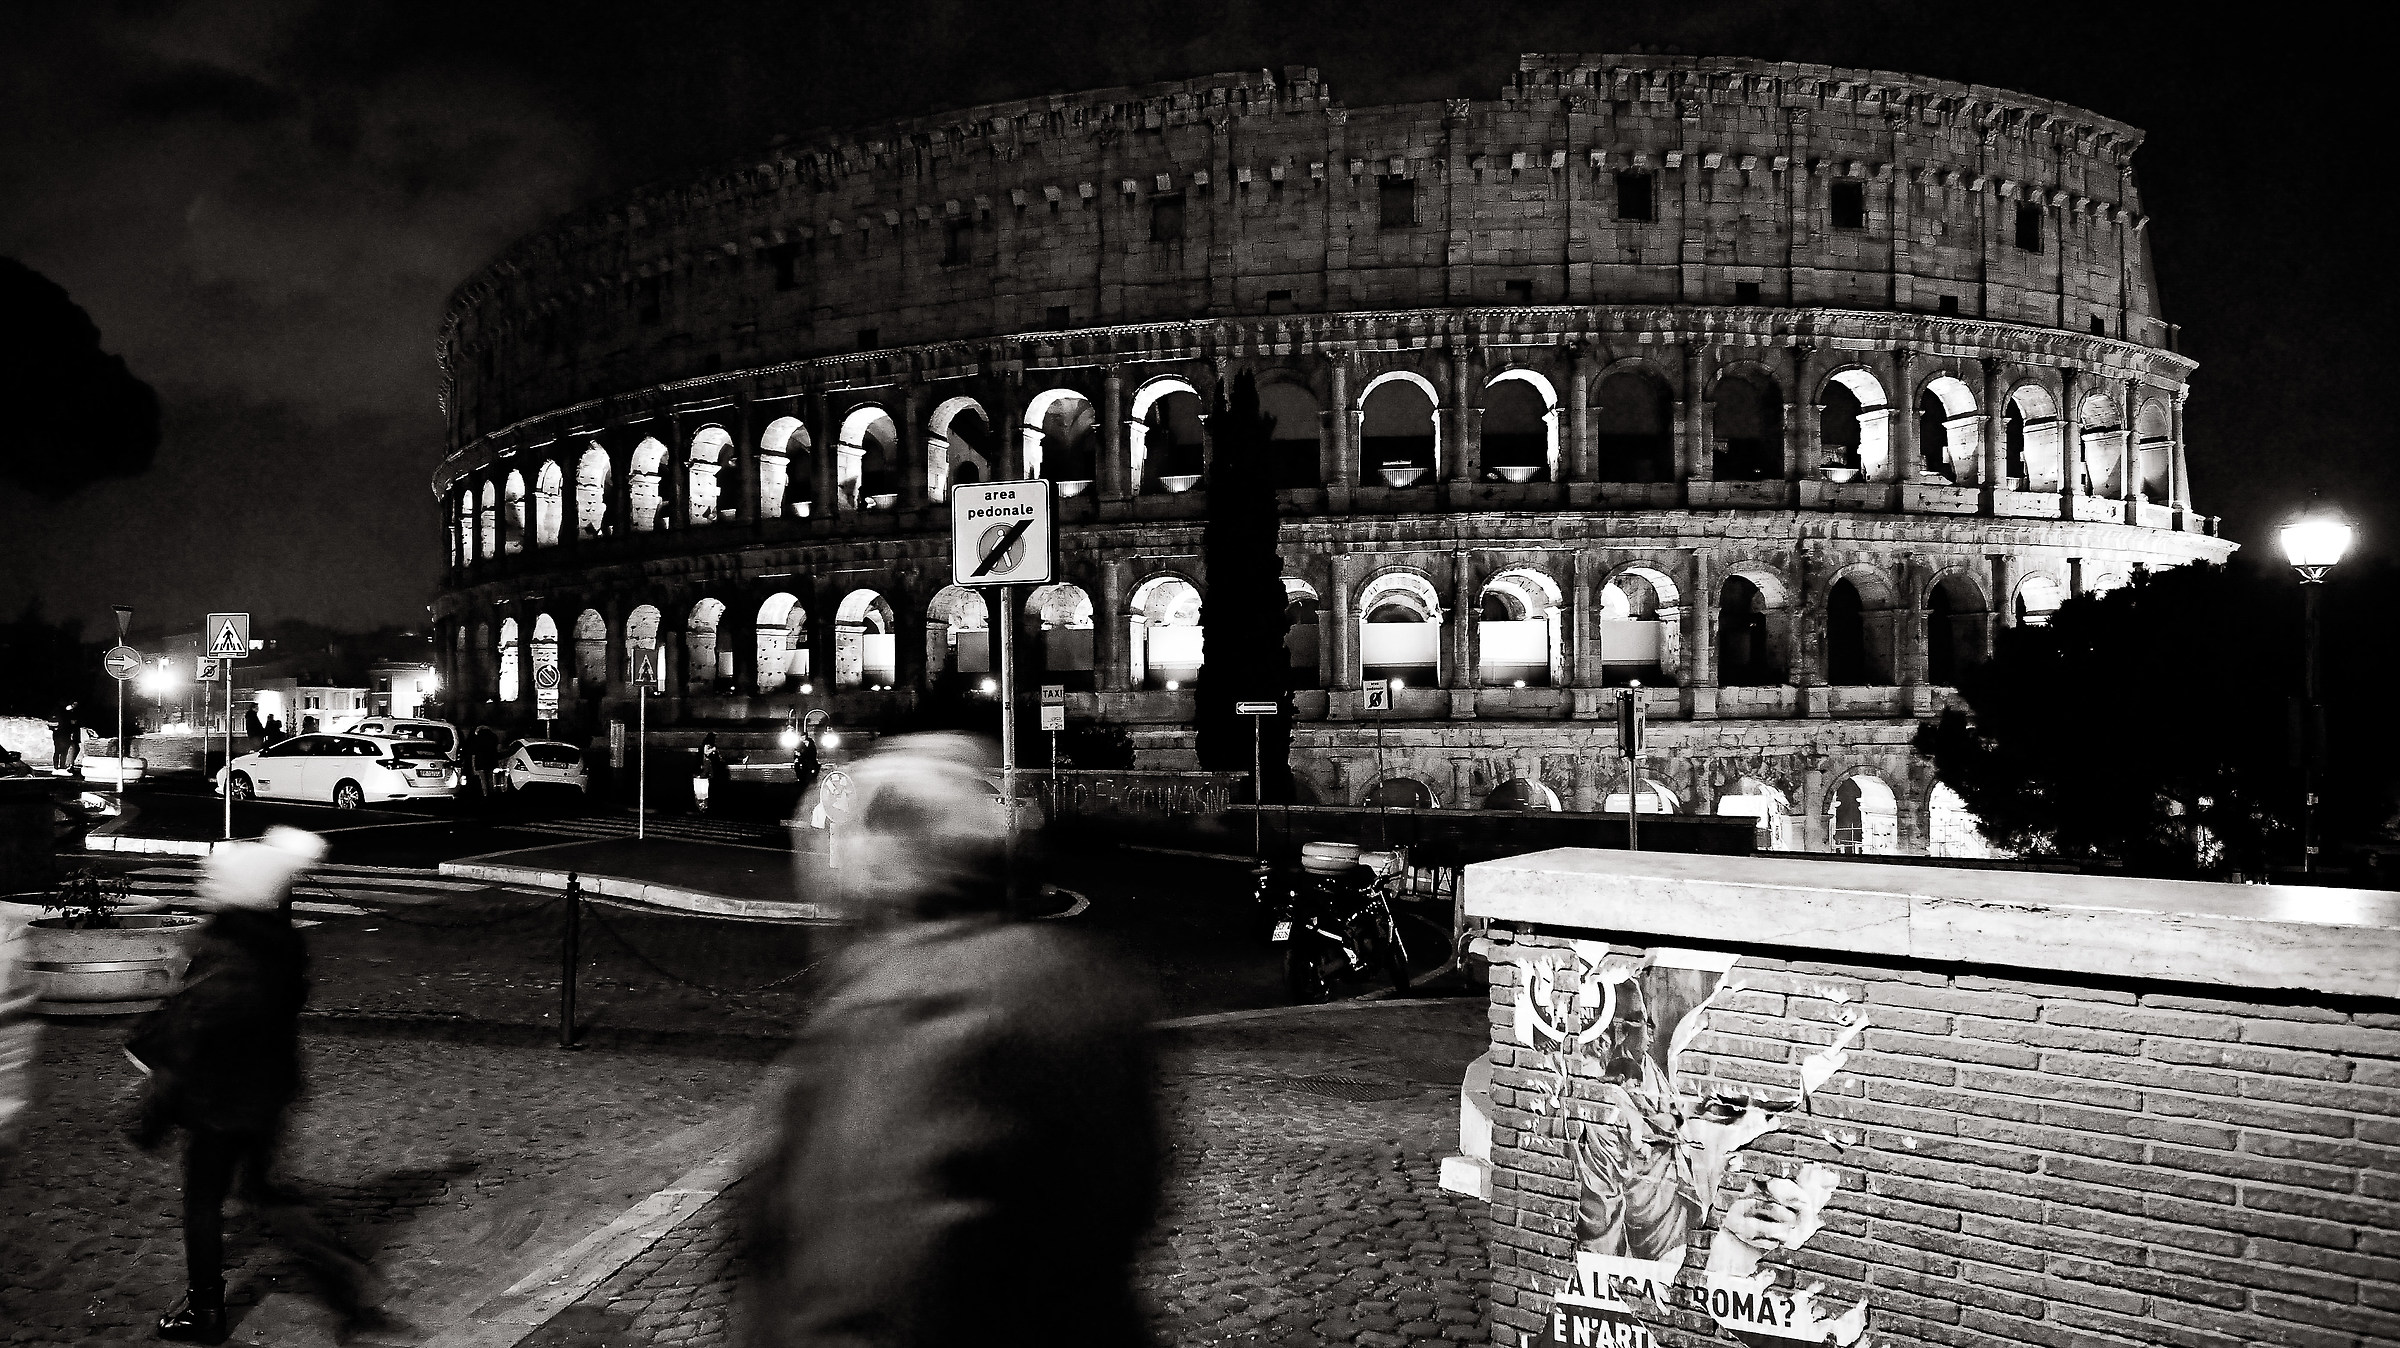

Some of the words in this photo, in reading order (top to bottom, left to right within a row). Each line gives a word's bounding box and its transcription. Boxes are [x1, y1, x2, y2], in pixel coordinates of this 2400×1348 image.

[985, 490, 1016, 501] area
[968, 503, 1034, 520] pedonale
[1043, 690, 1063, 698] TAXI
[1693, 1286, 1796, 1328] ROMA?
